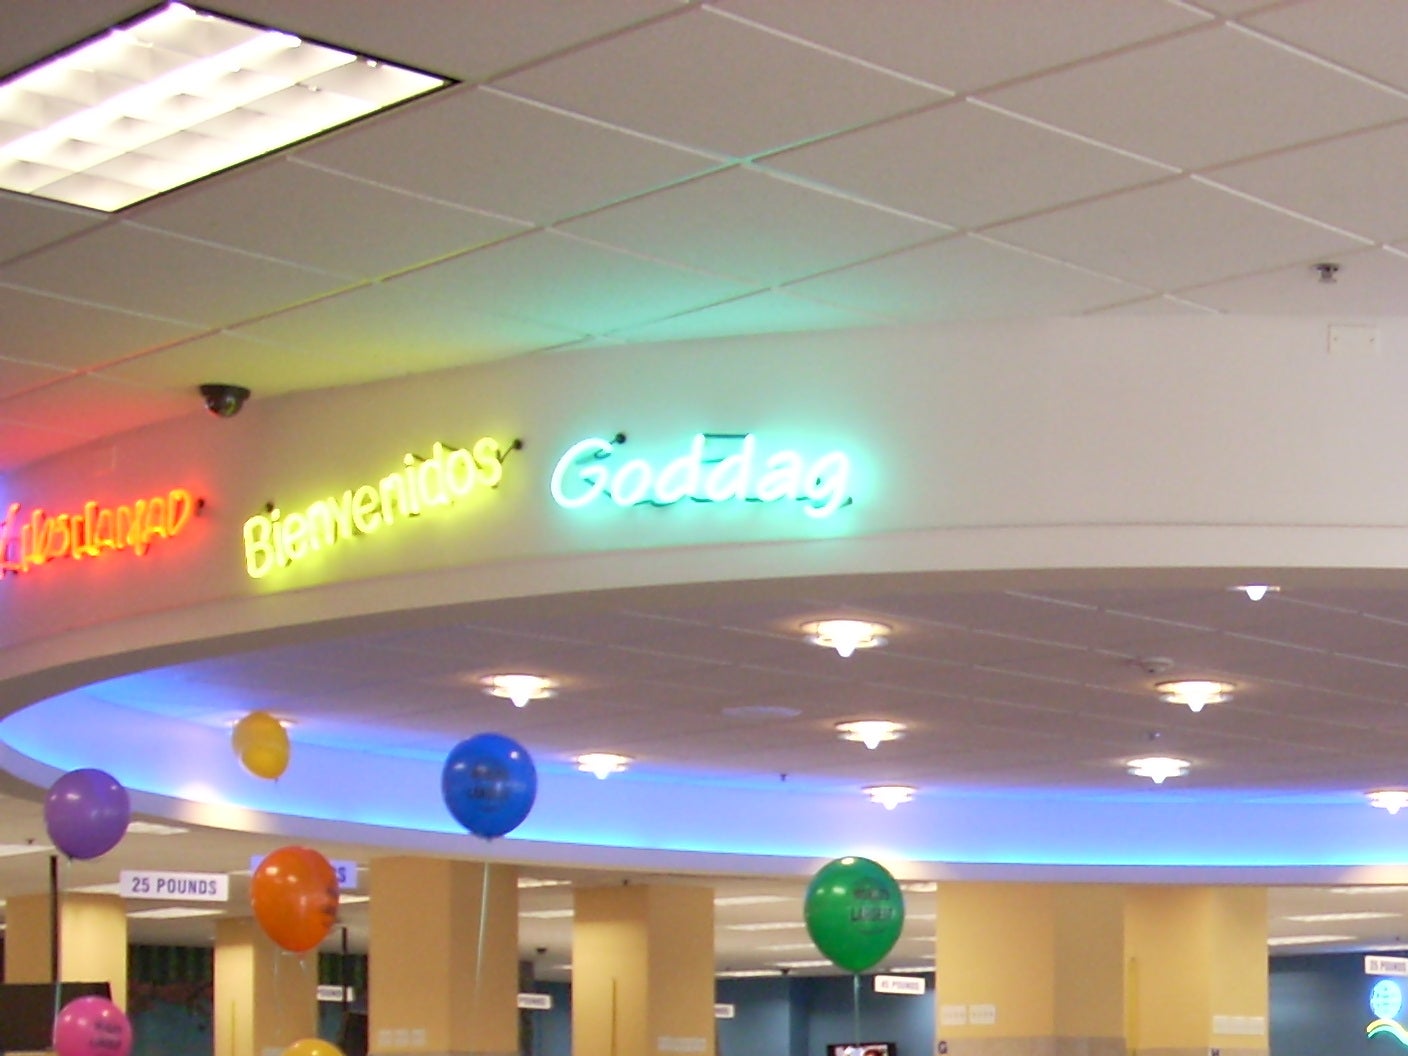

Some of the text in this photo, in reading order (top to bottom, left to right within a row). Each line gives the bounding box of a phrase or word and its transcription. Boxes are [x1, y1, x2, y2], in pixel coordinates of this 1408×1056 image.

[551, 434, 853, 518] Goddag
[243, 436, 502, 578] Bienvenidos
[131, 877, 217, 895] 25 POUNDS
[938, 1040, 948, 1055] G
